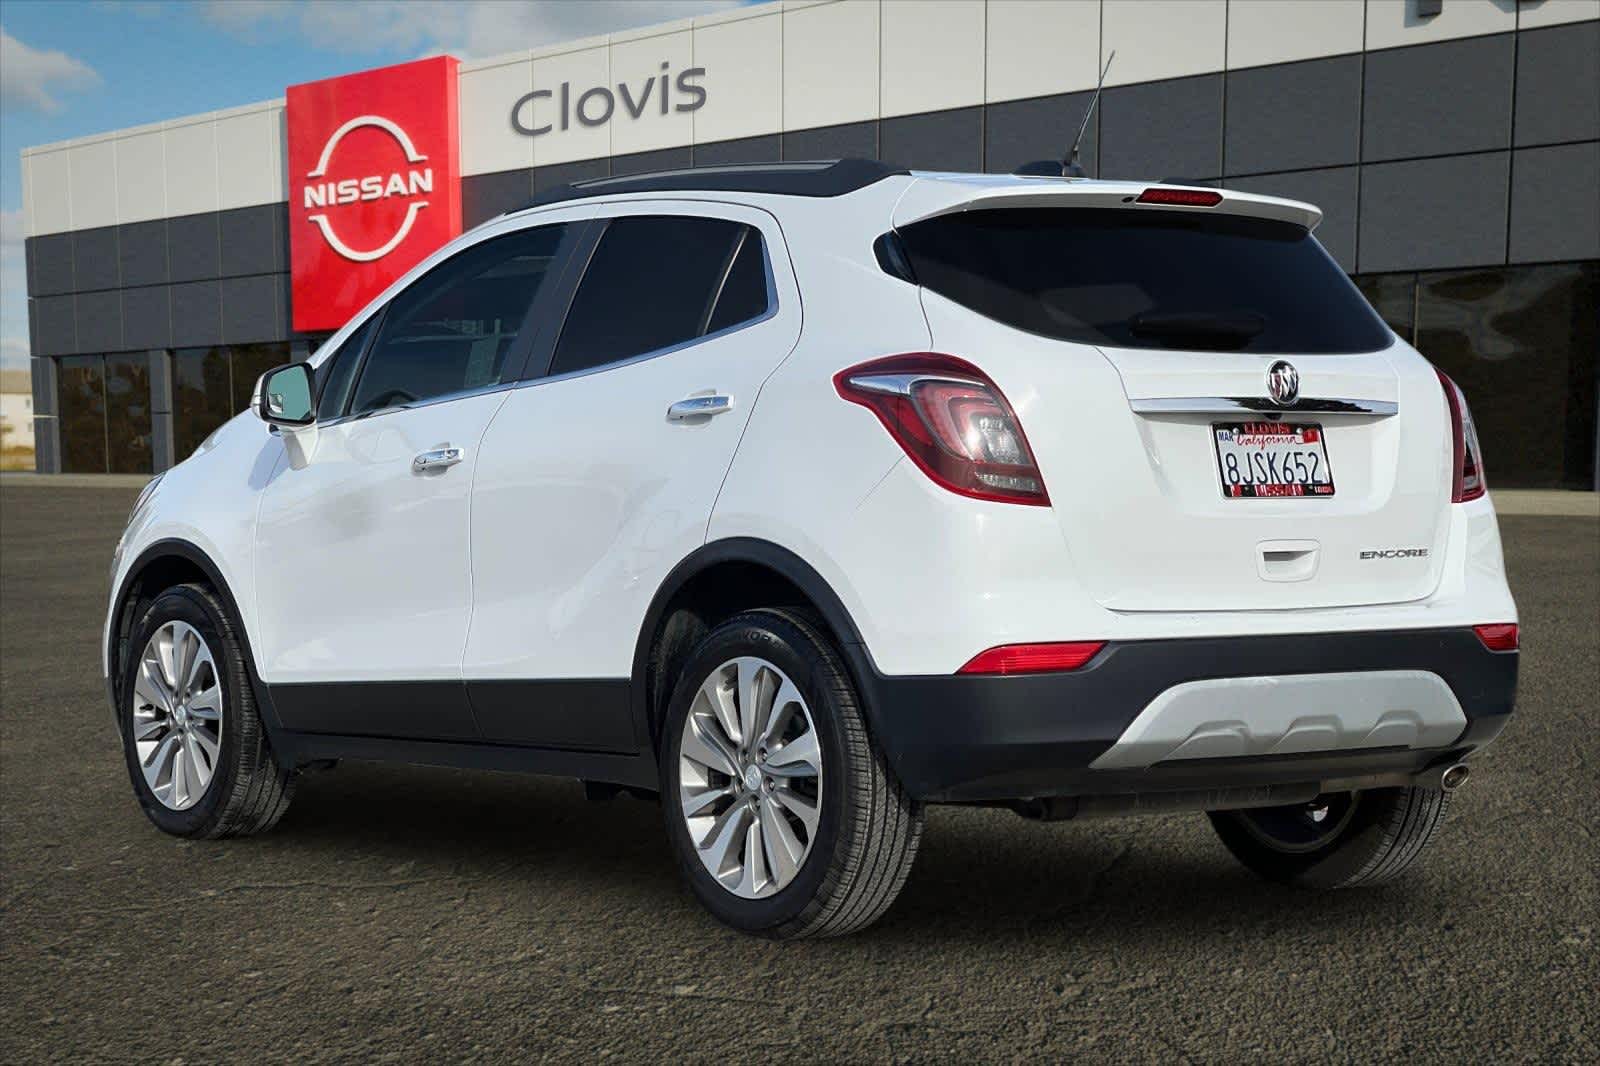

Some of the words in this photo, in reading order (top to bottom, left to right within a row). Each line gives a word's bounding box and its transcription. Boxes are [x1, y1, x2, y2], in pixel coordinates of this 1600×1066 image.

[304, 168, 433, 208] NISSAN
[1237, 434, 1298, 450] California
[1226, 452, 1323, 483] 8JSK652
[1360, 548, 1428, 559] ENCORE
